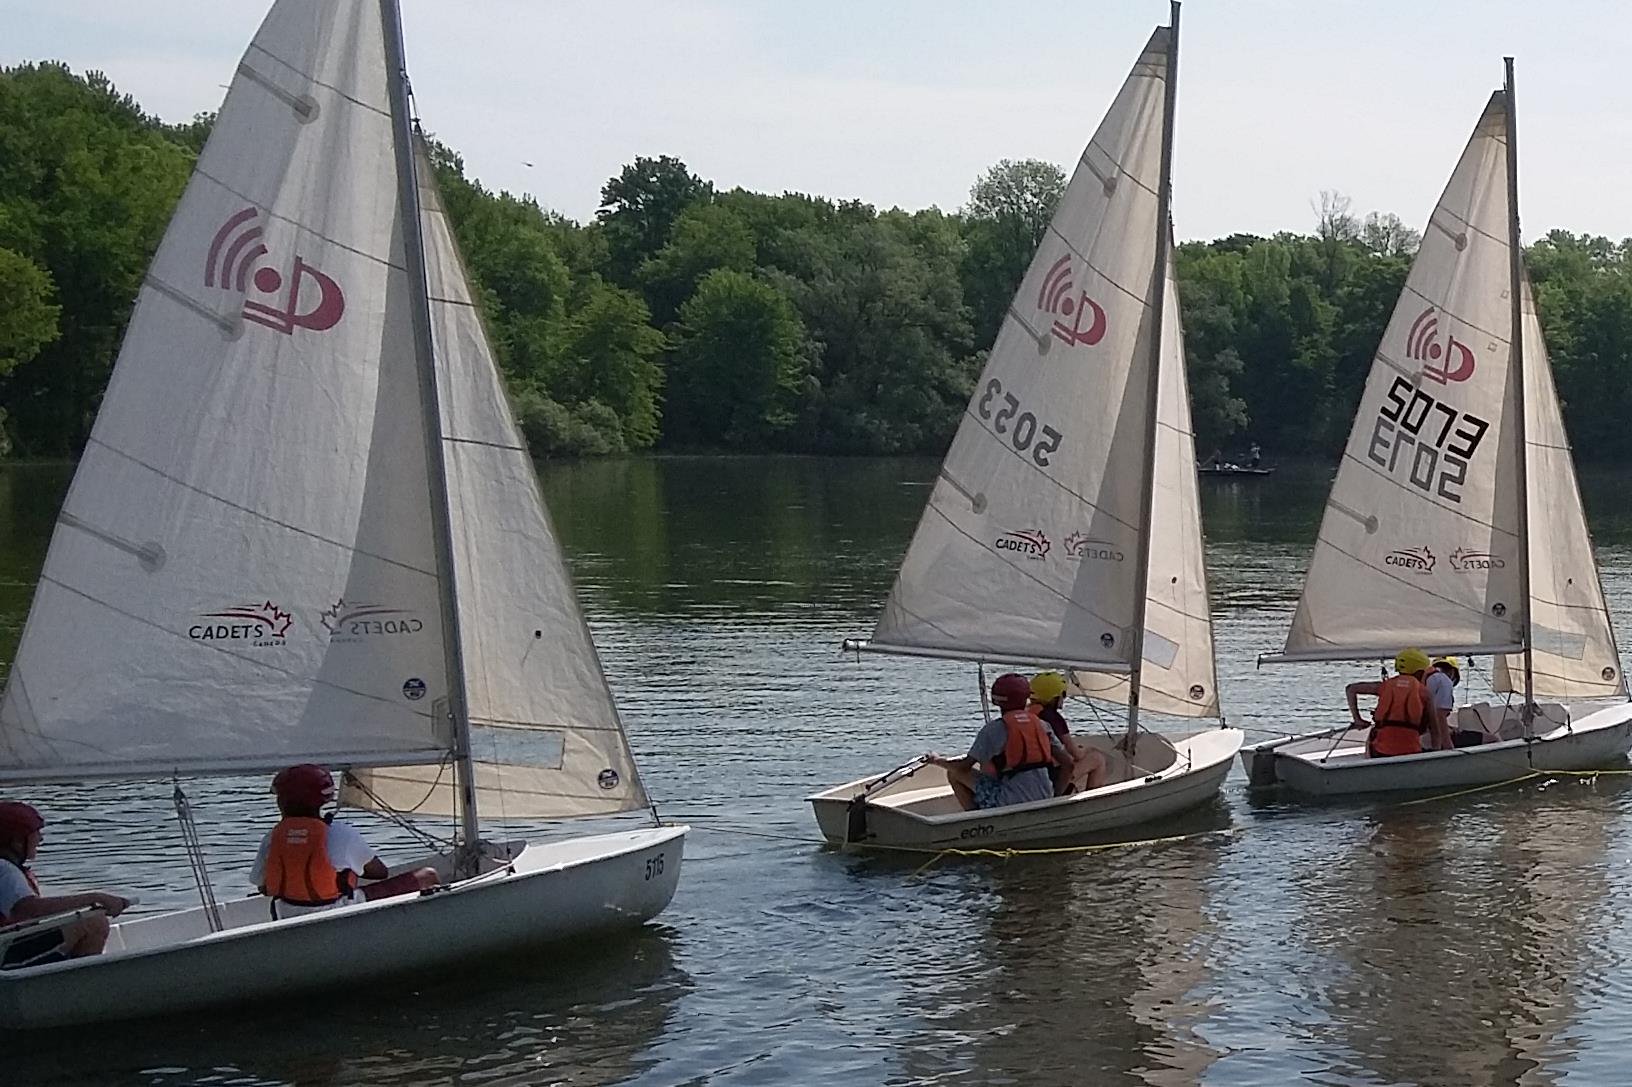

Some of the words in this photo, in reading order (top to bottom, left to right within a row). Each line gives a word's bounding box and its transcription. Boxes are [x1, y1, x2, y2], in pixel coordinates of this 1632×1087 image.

[1379, 375, 1490, 460] 5073
[995, 538, 1036, 554] CADETS
[1385, 555, 1423, 570] CADETS
[188, 624, 263, 640] CADETS
[960, 823, 994, 840] echo
